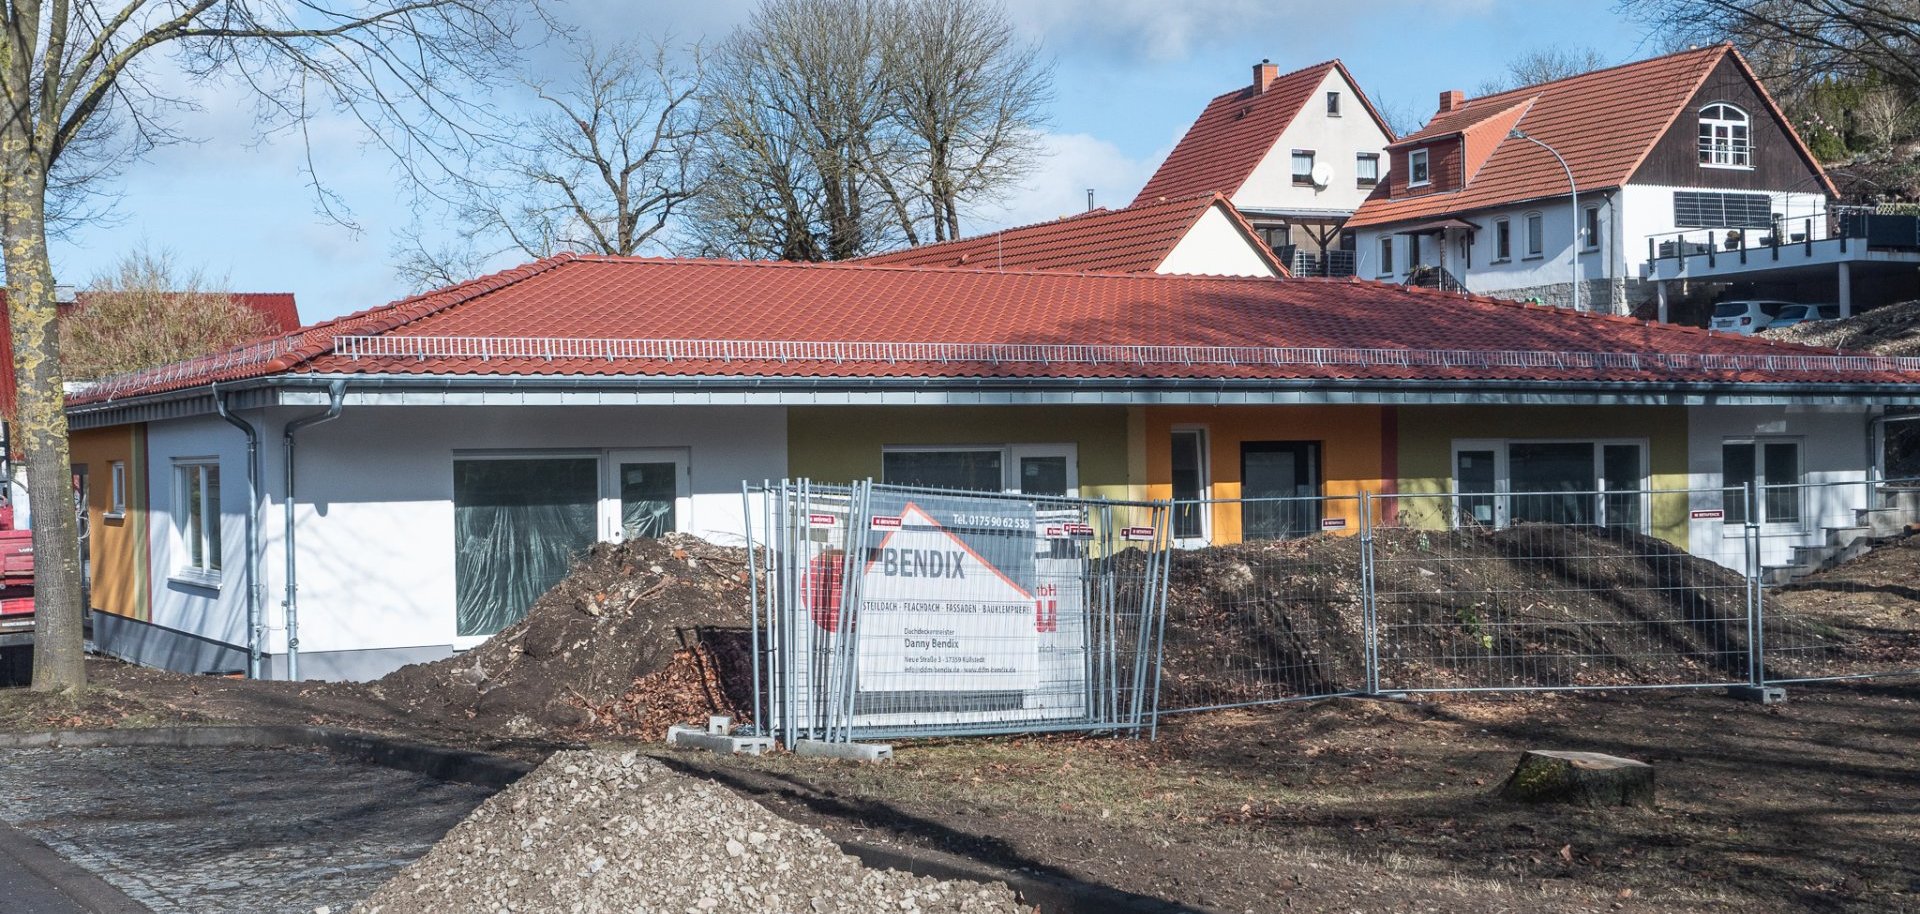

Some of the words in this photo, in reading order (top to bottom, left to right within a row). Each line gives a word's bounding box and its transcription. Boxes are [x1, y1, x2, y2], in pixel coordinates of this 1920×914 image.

[953, 514, 967, 525] Tel.
[969, 515, 990, 527] 0175
[991, 517, 1002, 527] 90
[1003, 518, 1013, 528] 62
[1015, 518, 1030, 529] 538
[884, 548, 965, 579] BENDIX
[862, 601, 897, 612] STEILDACH
[903, 602, 940, 613] FLACHDACH
[946, 603, 977, 614] FASSADEN
[904, 638, 930, 651] Danny
[931, 638, 960, 649] Bendix
